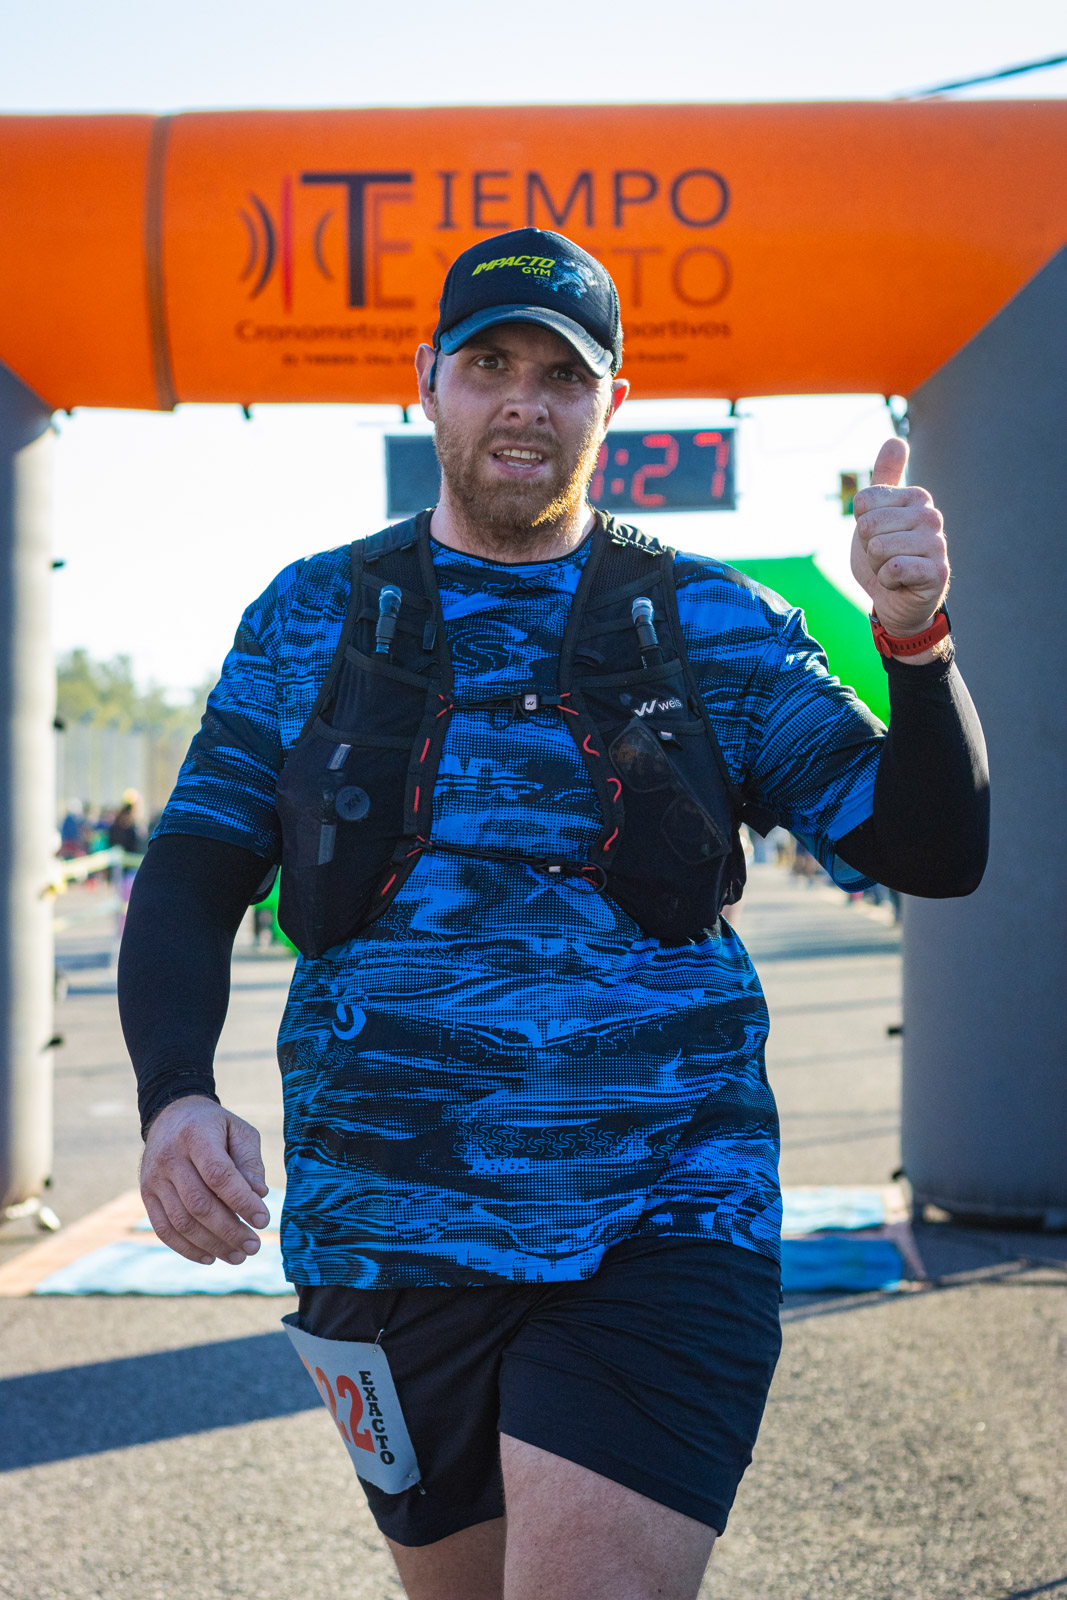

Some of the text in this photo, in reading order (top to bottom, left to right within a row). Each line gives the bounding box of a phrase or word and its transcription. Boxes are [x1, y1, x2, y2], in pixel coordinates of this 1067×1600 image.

[471, 255, 556, 277] IMPACTO
[521, 266, 551, 277] GYM
[301, 1354, 376, 1454] 22
[359, 1371, 395, 1465] EXACTO
